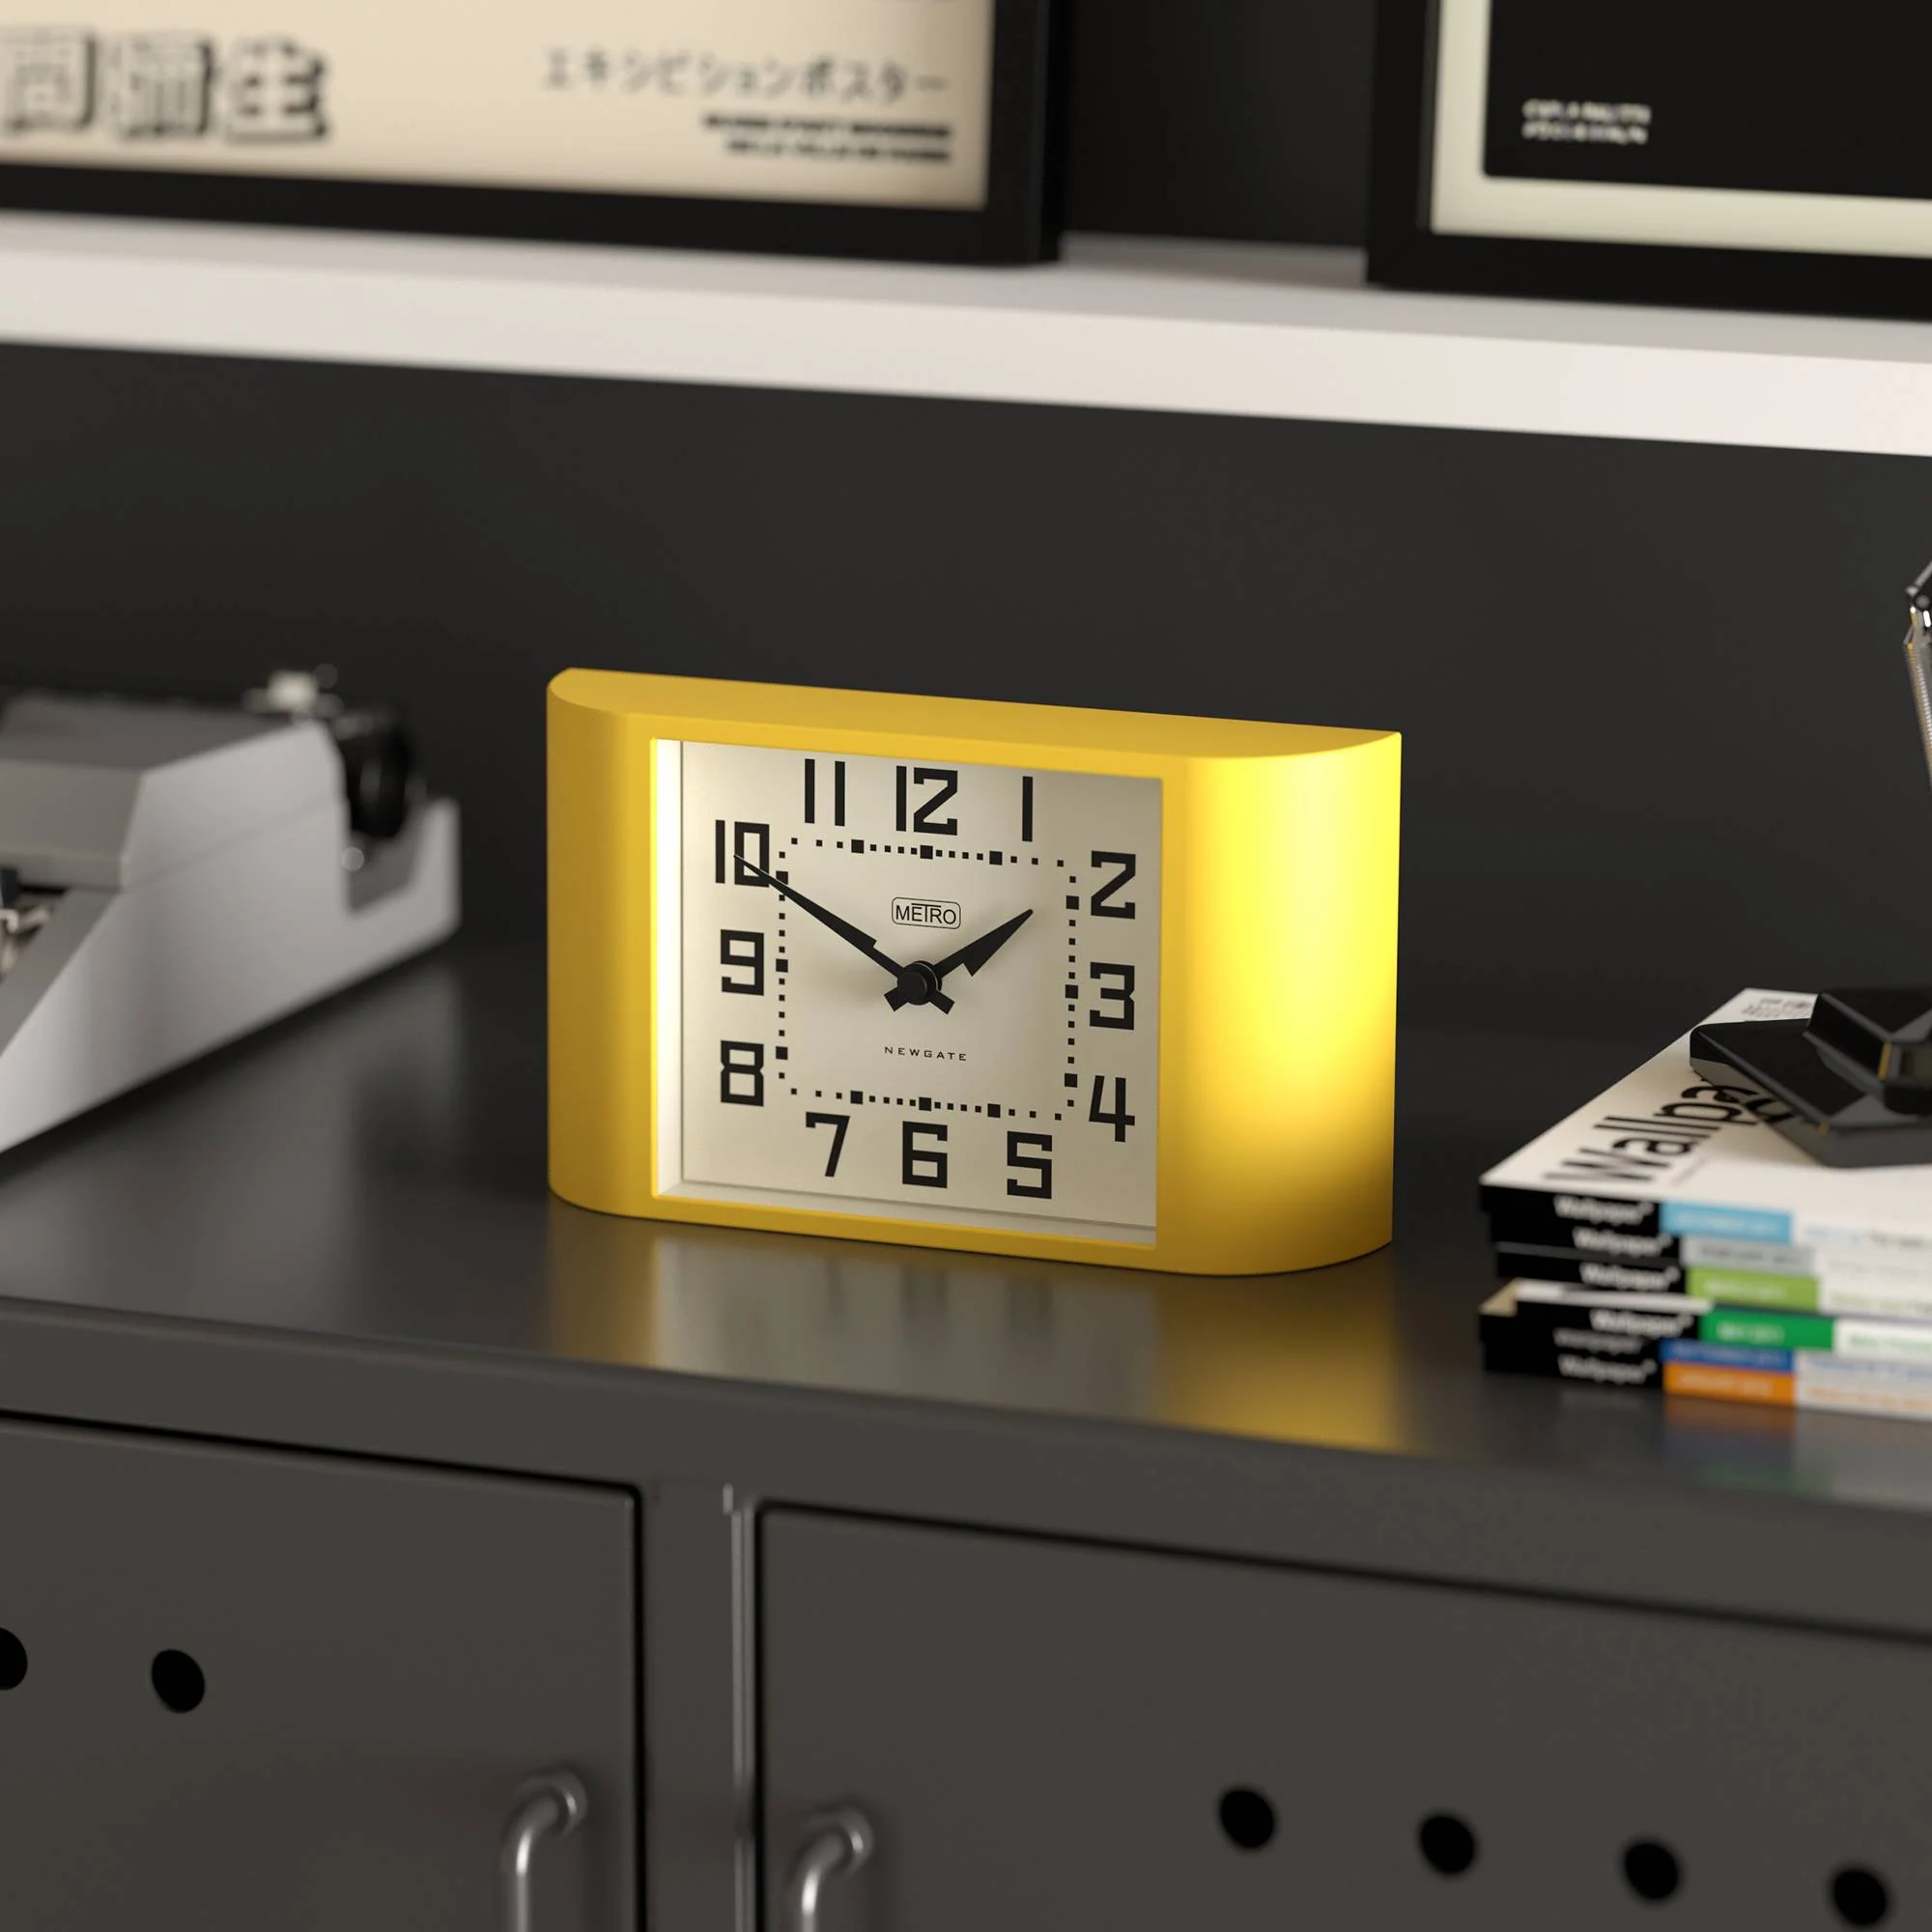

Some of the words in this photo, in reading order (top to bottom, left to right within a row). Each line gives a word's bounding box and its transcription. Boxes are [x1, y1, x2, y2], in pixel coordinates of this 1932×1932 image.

[805, 758, 845, 826] 11
[896, 765, 958, 836] 12
[1022, 776, 1033, 841] 1
[716, 819, 769, 888] 10
[1091, 850, 1135, 919] 2
[895, 902, 956, 924] METRO
[721, 929, 764, 996] 9
[1090, 961, 1134, 1030] 3
[721, 1040, 764, 1107] 8
[884, 1046, 966, 1061] NEWGATE
[1089, 1075, 1135, 1142] 4
[806, 1112, 850, 1177] 7
[902, 1122, 948, 1188] 6
[1007, 1131, 1053, 1199] 5
